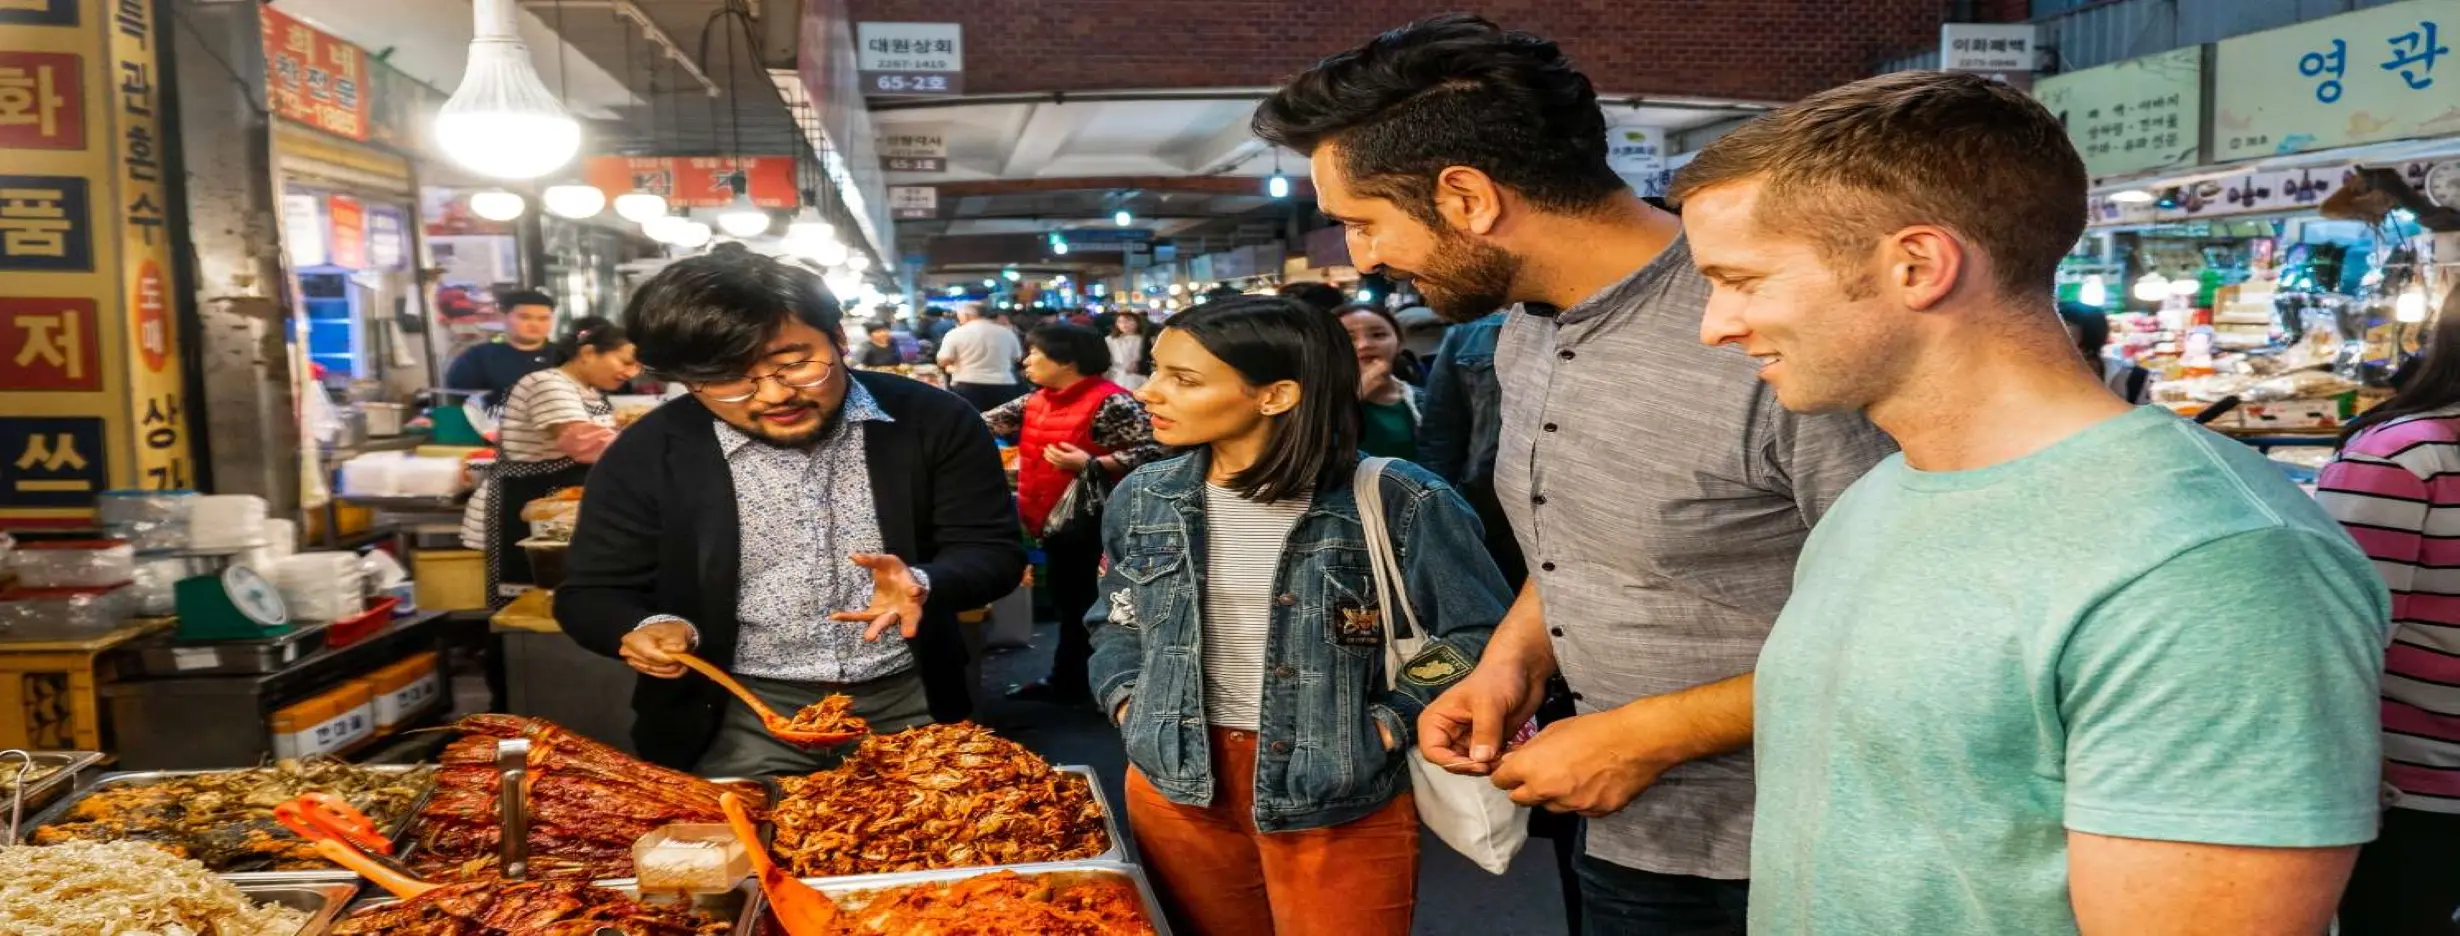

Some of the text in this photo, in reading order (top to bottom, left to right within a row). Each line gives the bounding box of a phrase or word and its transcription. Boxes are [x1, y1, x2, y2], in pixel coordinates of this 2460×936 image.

[869, 36, 952, 54] 대원상회
[877, 74, 948, 90] 65-2호
[139, 276, 165, 354] 도매
[143, 393, 185, 491] 상가
